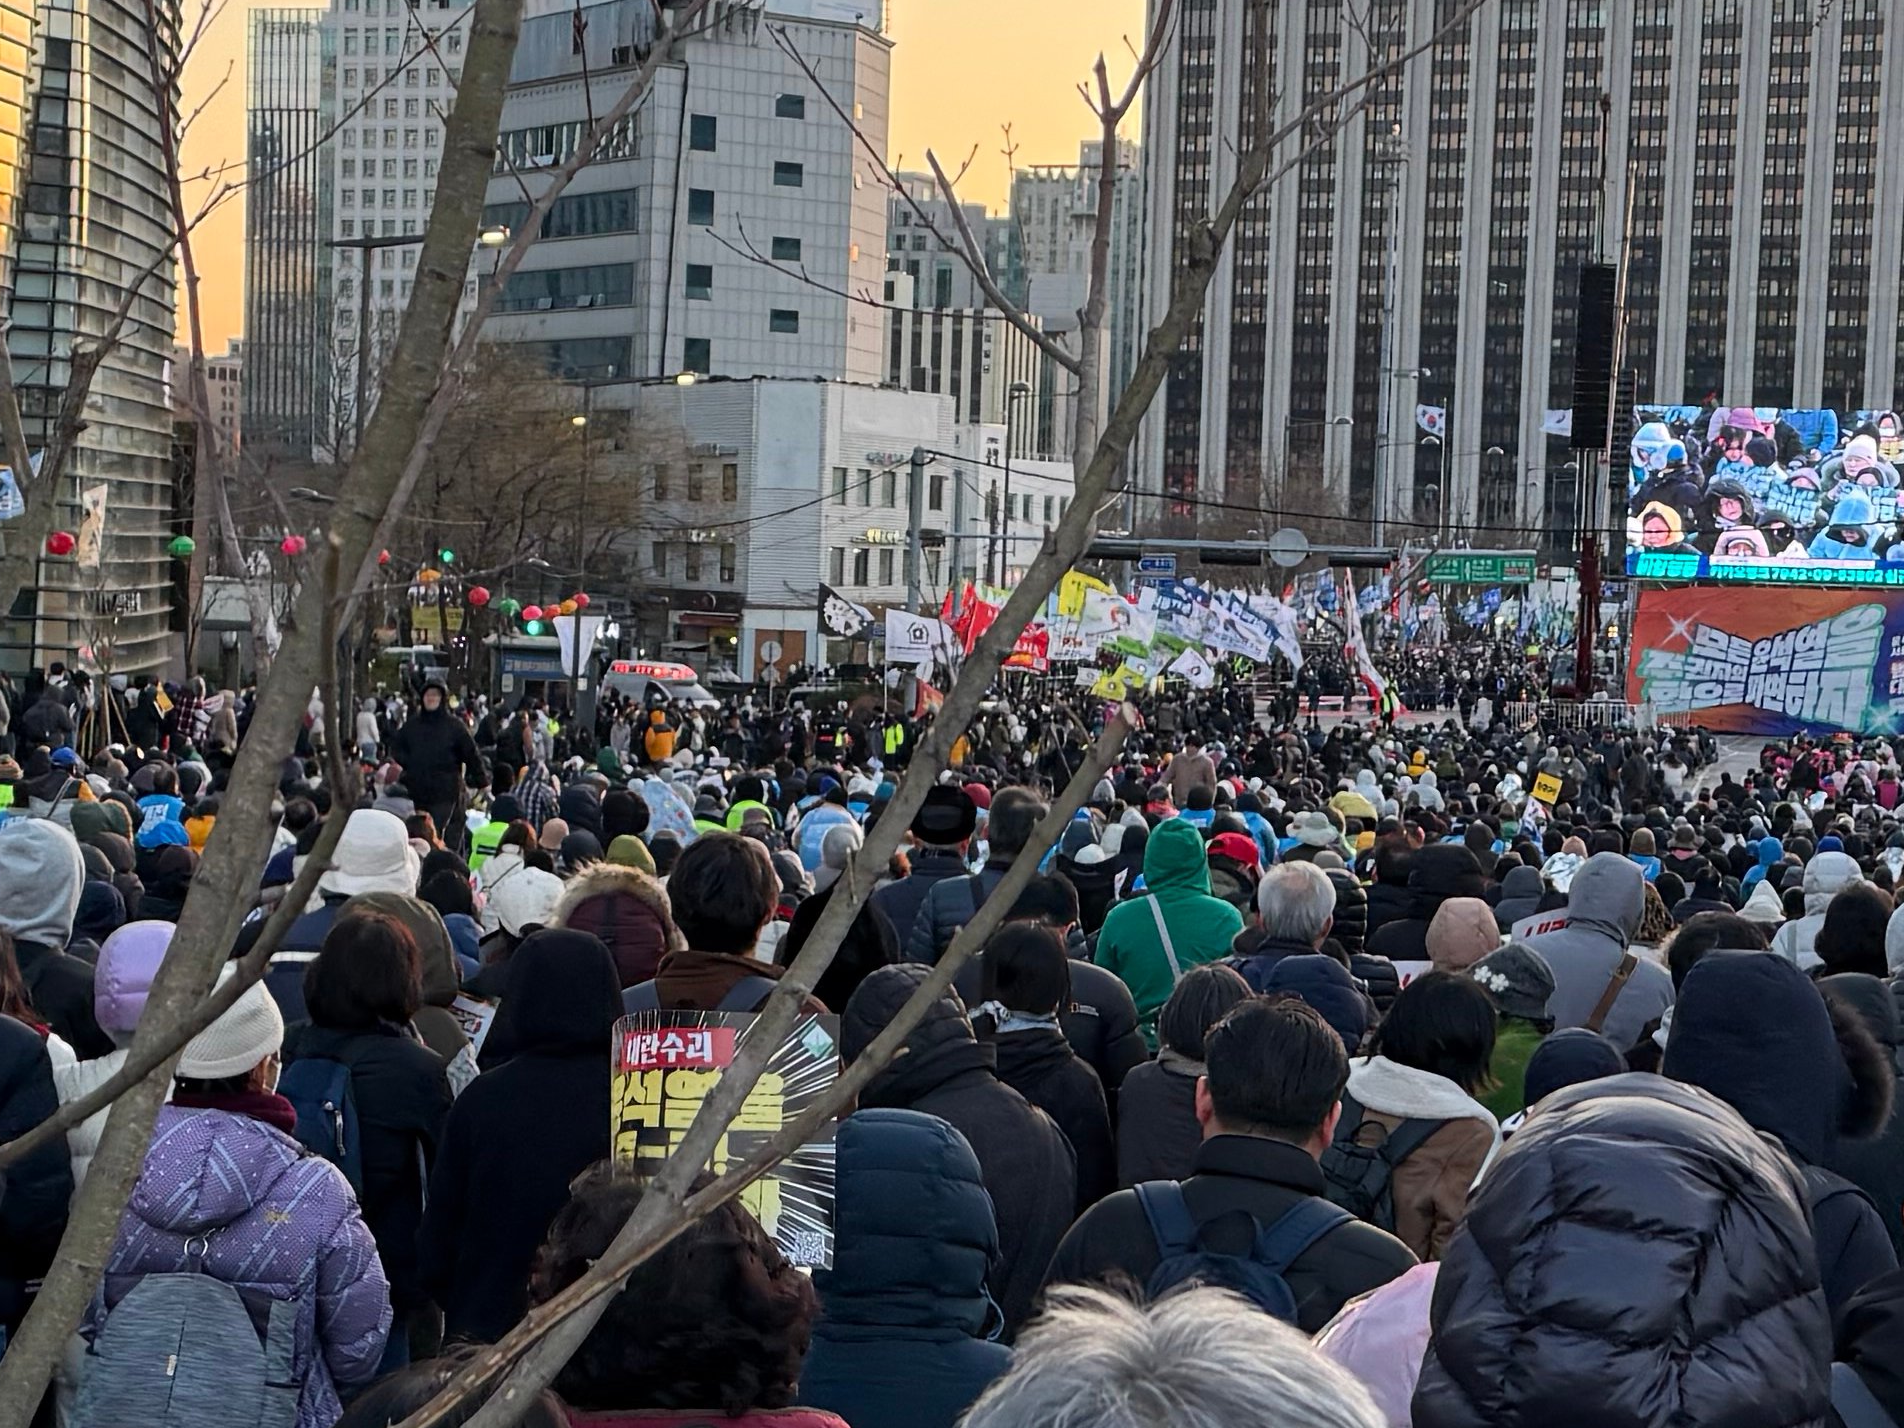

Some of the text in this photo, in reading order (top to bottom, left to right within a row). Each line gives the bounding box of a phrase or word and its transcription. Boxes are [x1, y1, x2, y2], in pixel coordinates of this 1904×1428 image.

[1695, 623, 1754, 666] 모든
[1750, 603, 1887, 673] 윤석열을
[1746, 668, 1873, 728] 파면하자
